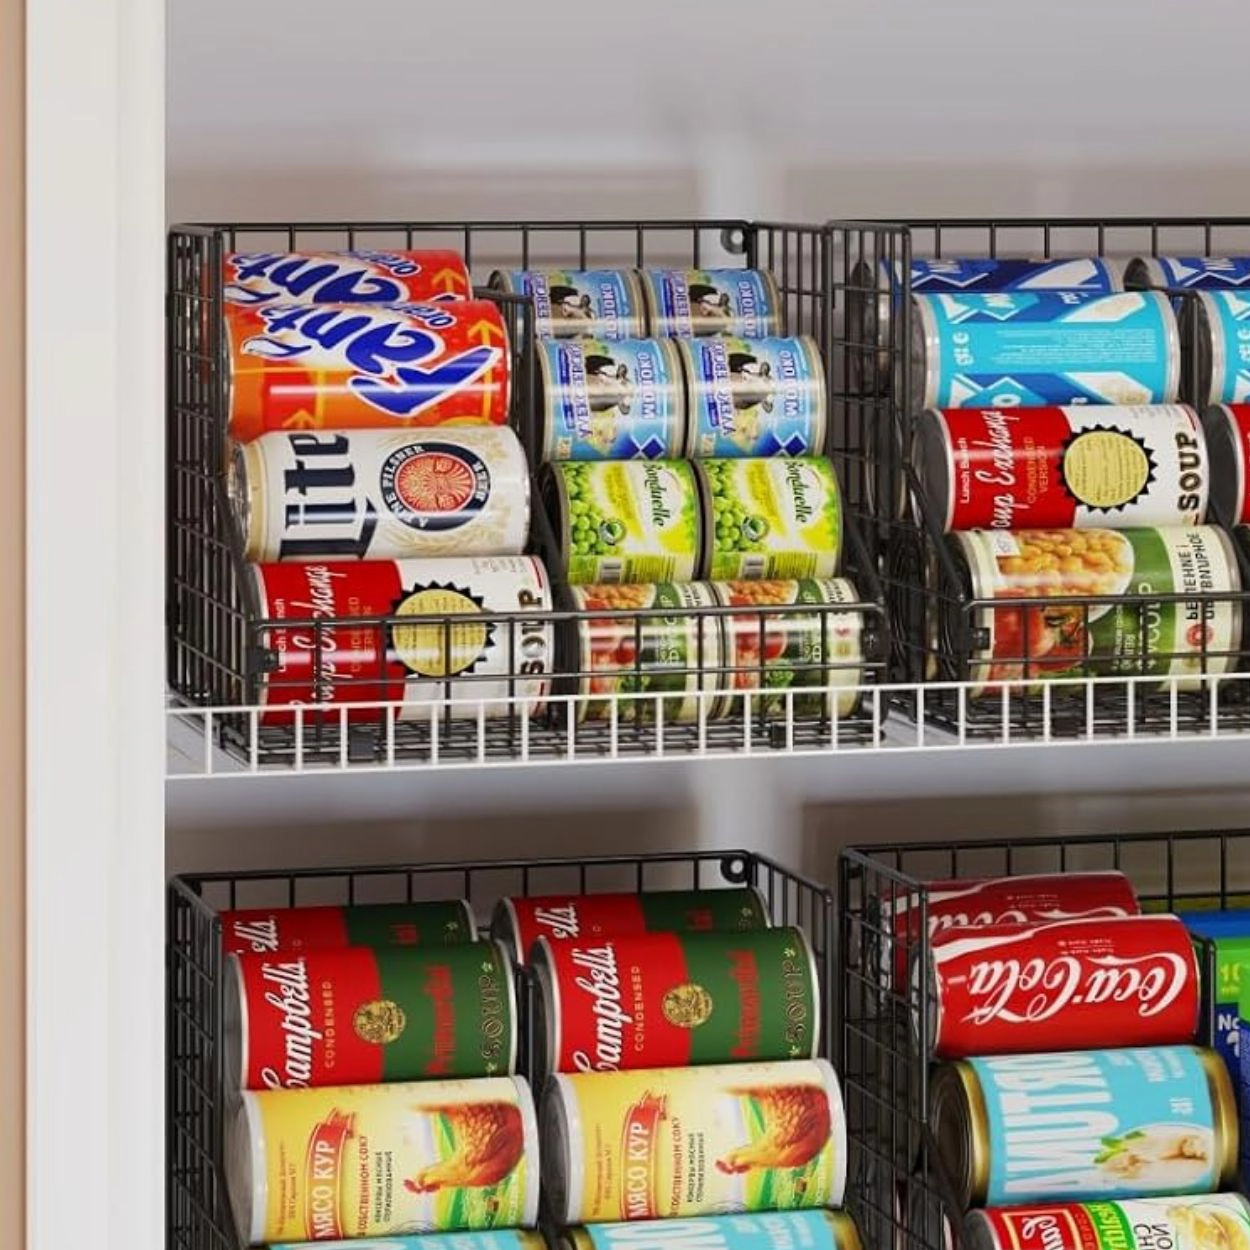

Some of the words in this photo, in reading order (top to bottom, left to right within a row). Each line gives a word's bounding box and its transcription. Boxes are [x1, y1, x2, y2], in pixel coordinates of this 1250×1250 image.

[280, 432, 378, 558] Lite
[1175, 432, 1201, 512] SOUP
[631, 966, 646, 1052] CONDENSED
[315, 1140, 337, 1180] КУР
[629, 1121, 649, 1161] КУР
[627, 1167, 649, 1219] МЯСО
